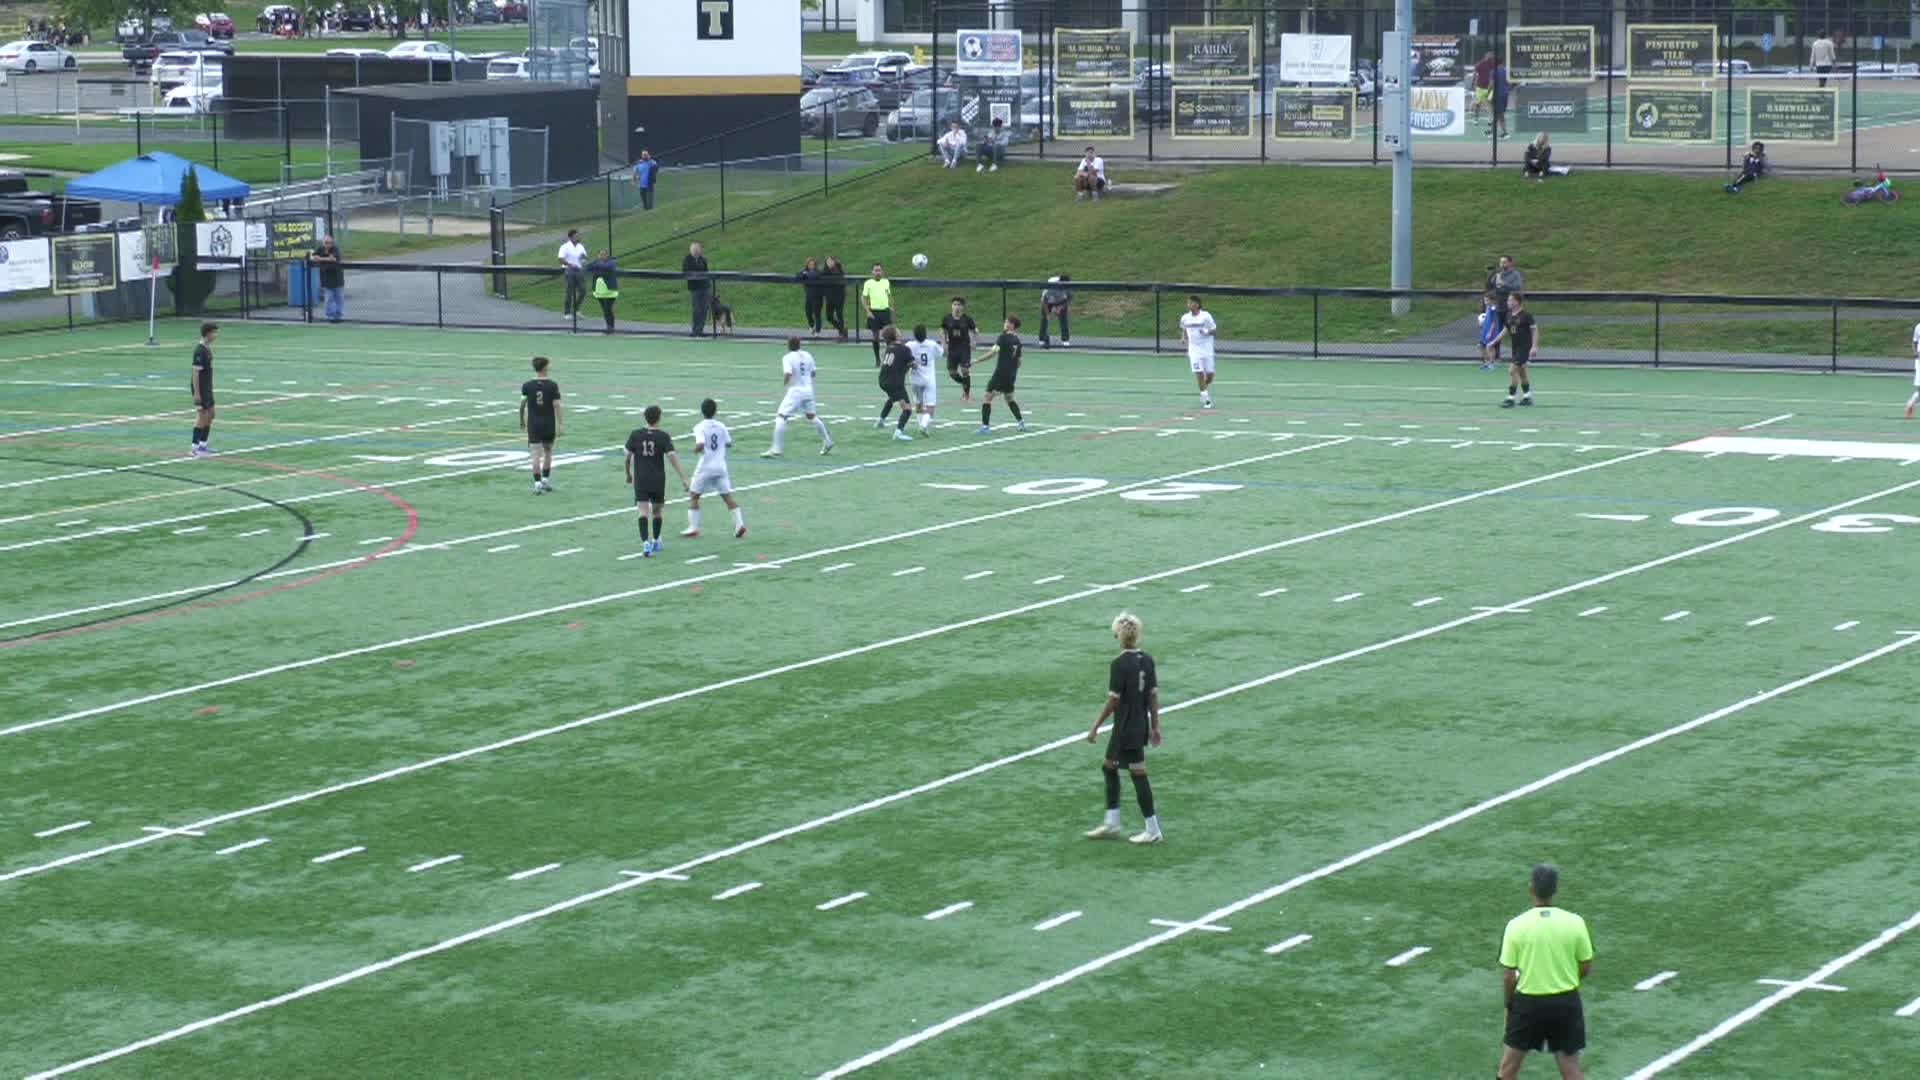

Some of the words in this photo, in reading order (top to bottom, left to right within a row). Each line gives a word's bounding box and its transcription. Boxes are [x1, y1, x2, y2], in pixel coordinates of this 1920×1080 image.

[701, 1, 729, 36] T
[920, 353, 928, 366] 9
[642, 439, 655, 457] 13
[710, 433, 718, 451] 8
